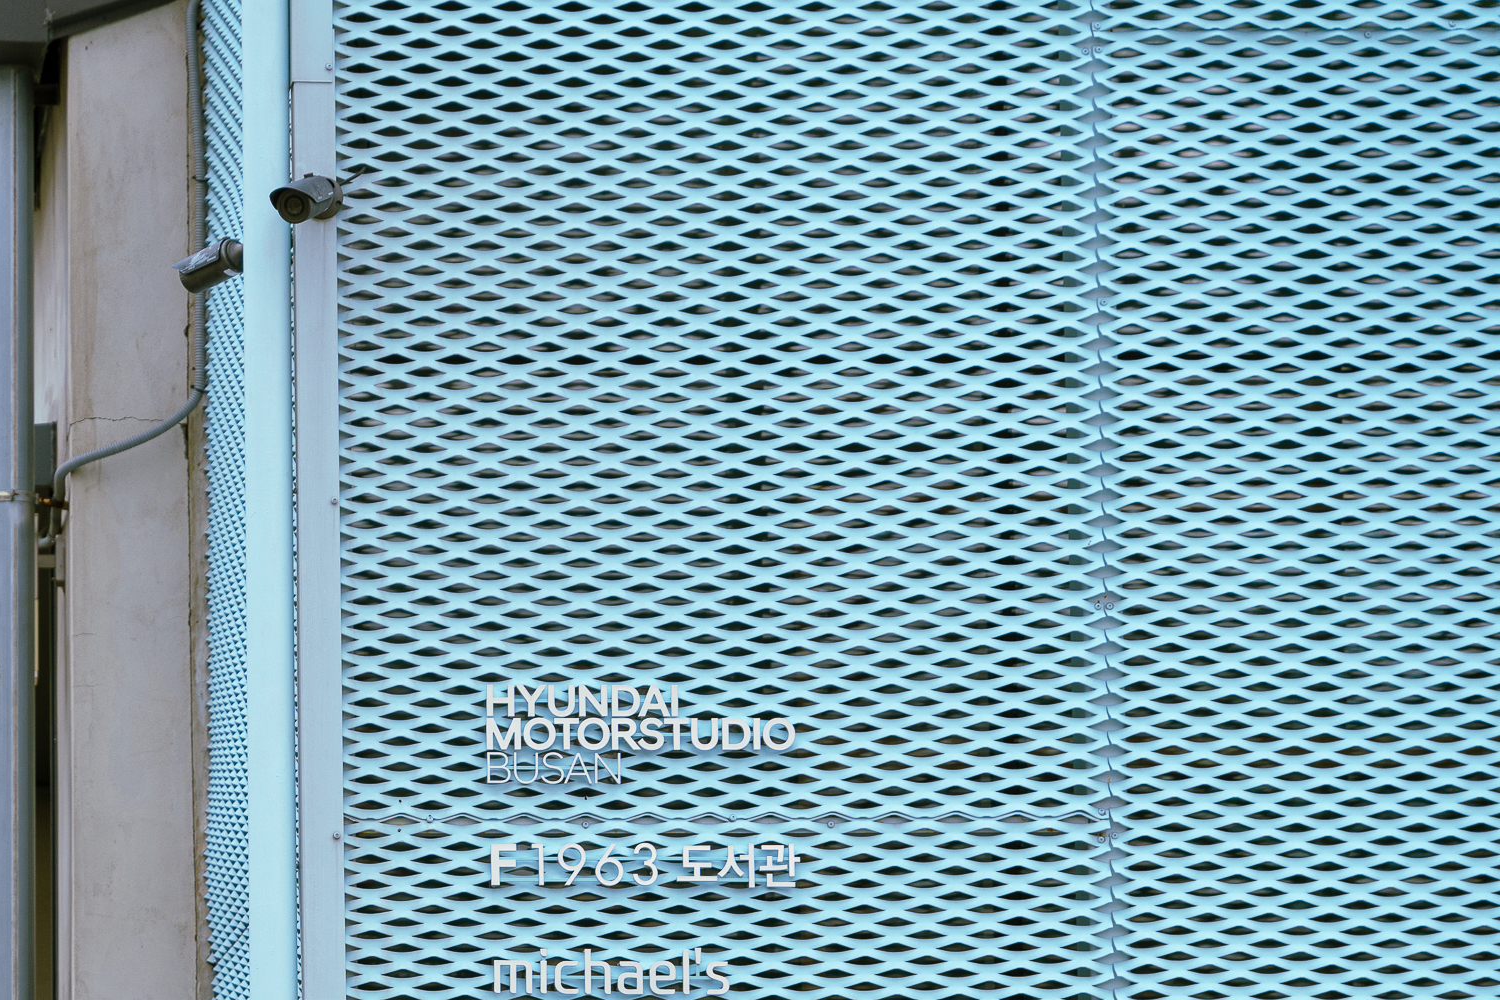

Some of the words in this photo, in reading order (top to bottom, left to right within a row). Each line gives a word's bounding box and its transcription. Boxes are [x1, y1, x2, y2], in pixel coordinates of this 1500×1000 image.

[486, 684, 679, 717] HYUNDAI
[486, 717, 796, 751] MOTORSTUDIO
[486, 752, 622, 785] BUSAN
[490, 842, 659, 886] F1963
[676, 843, 801, 888] 도서관
[493, 947, 730, 995] michael's
